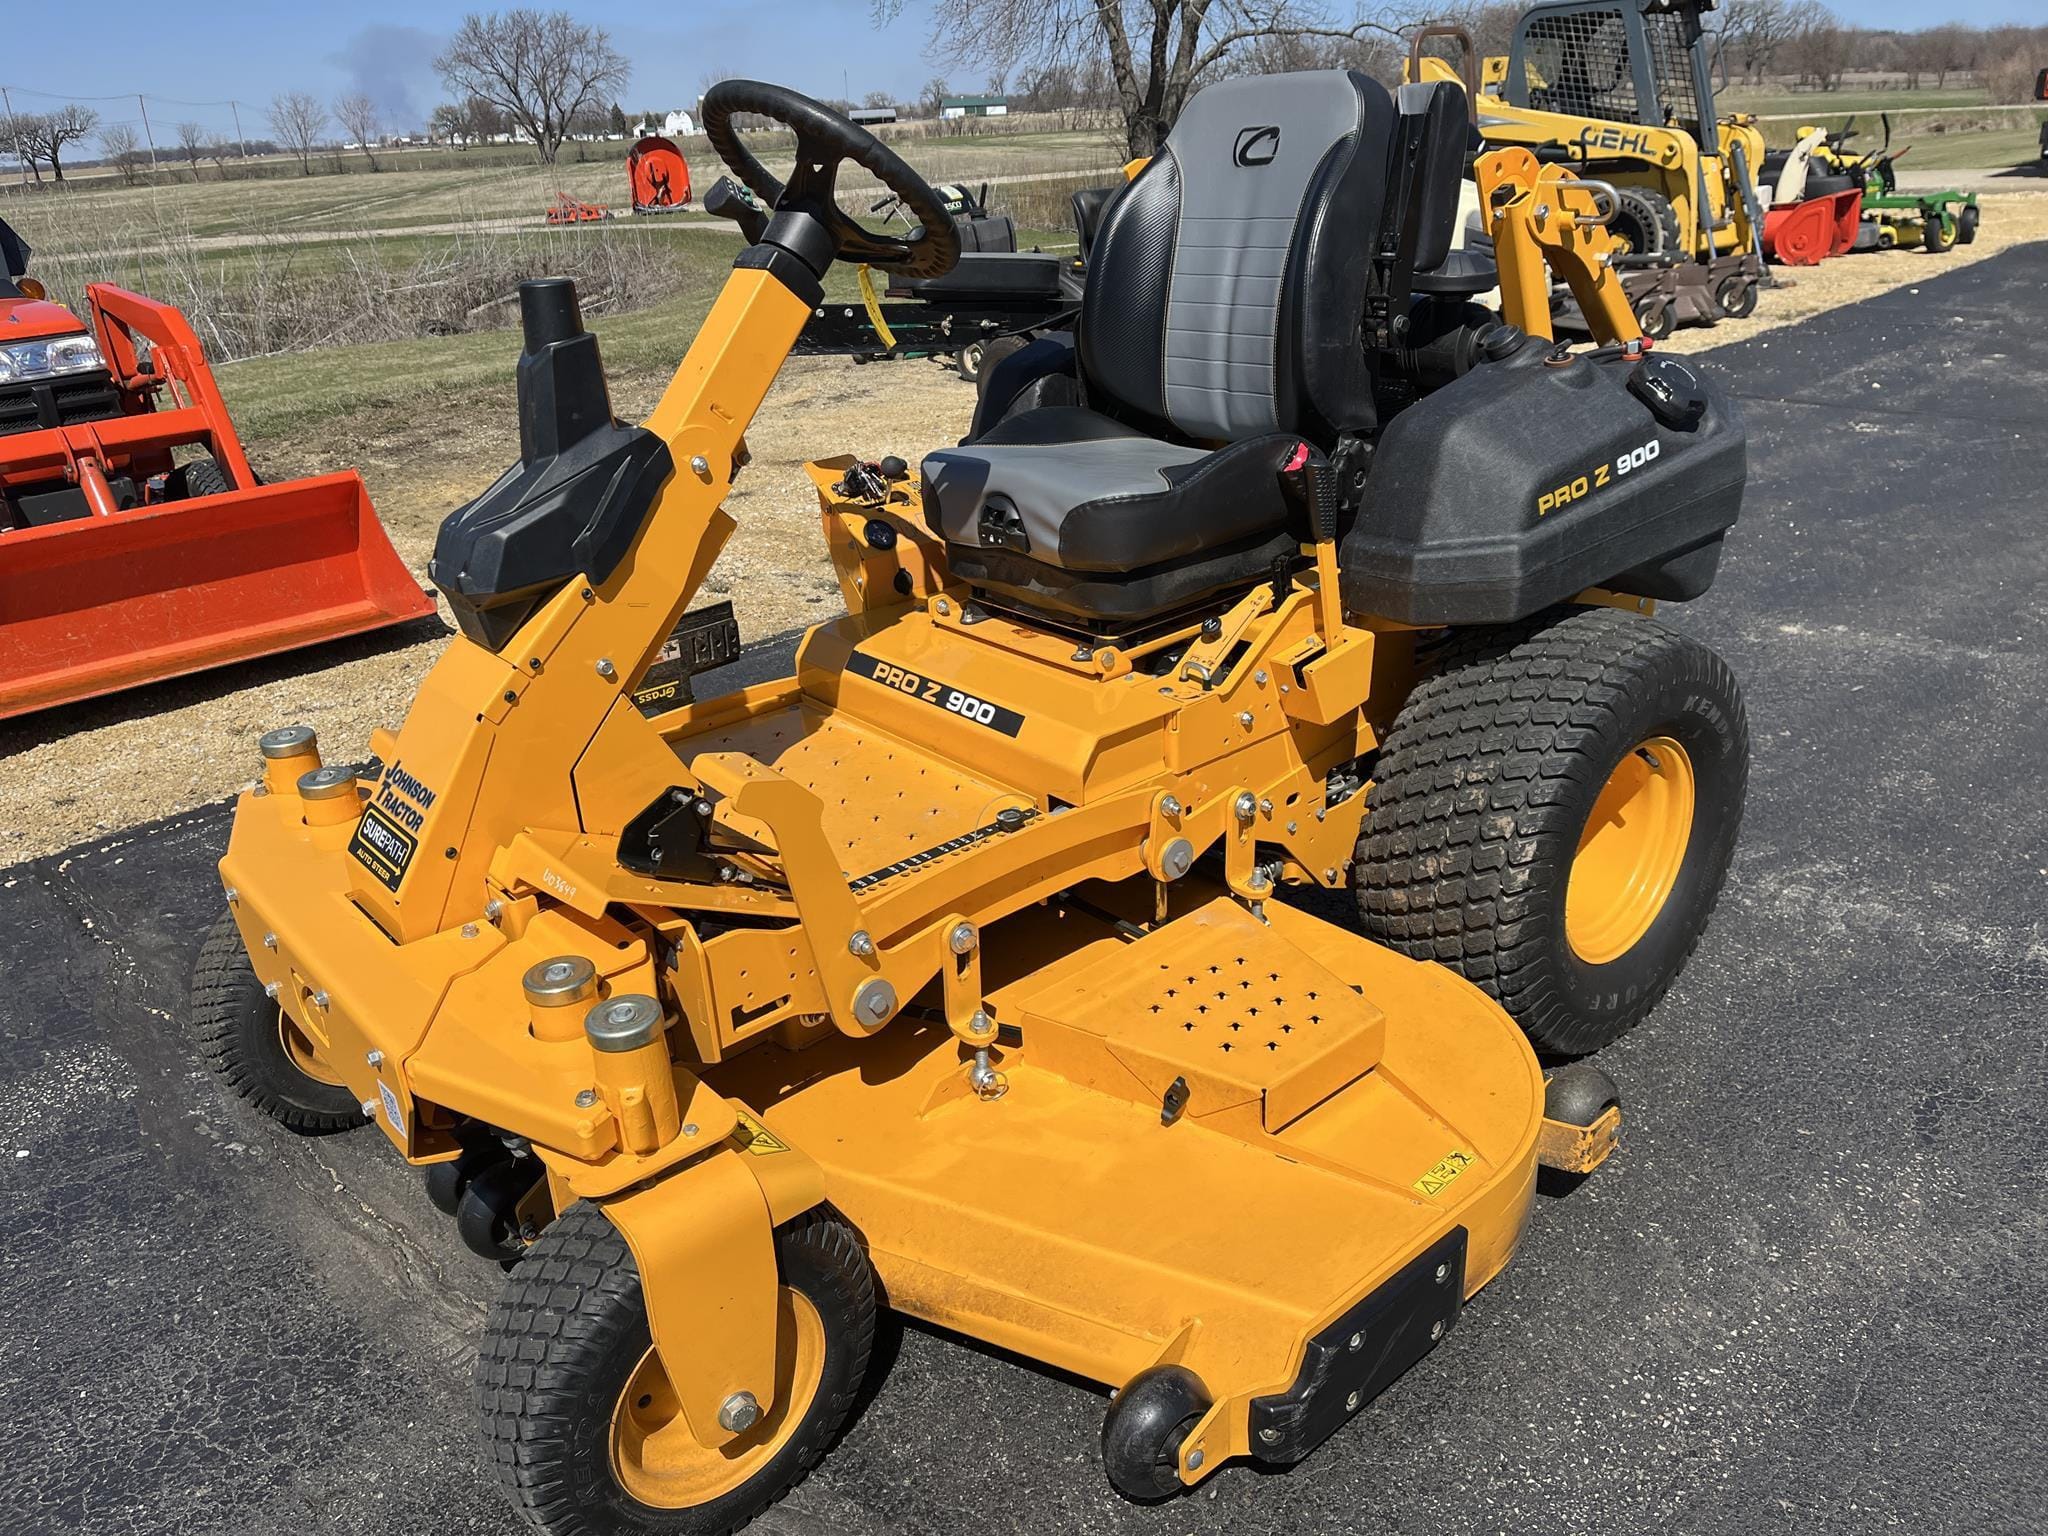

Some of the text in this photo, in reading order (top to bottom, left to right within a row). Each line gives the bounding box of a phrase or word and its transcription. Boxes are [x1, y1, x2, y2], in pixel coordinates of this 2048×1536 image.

[1580, 125, 1657, 156] GEHL
[1538, 439, 1660, 516] PRO Z 900
[638, 686, 676, 704] Grass
[872, 662, 996, 725] PRO Z 900
[376, 780, 425, 833] TRACTOR
[385, 759, 437, 810] JOHNSON
[356, 847, 391, 882] AUTO STEER
[363, 817, 408, 867] SUREPATH
